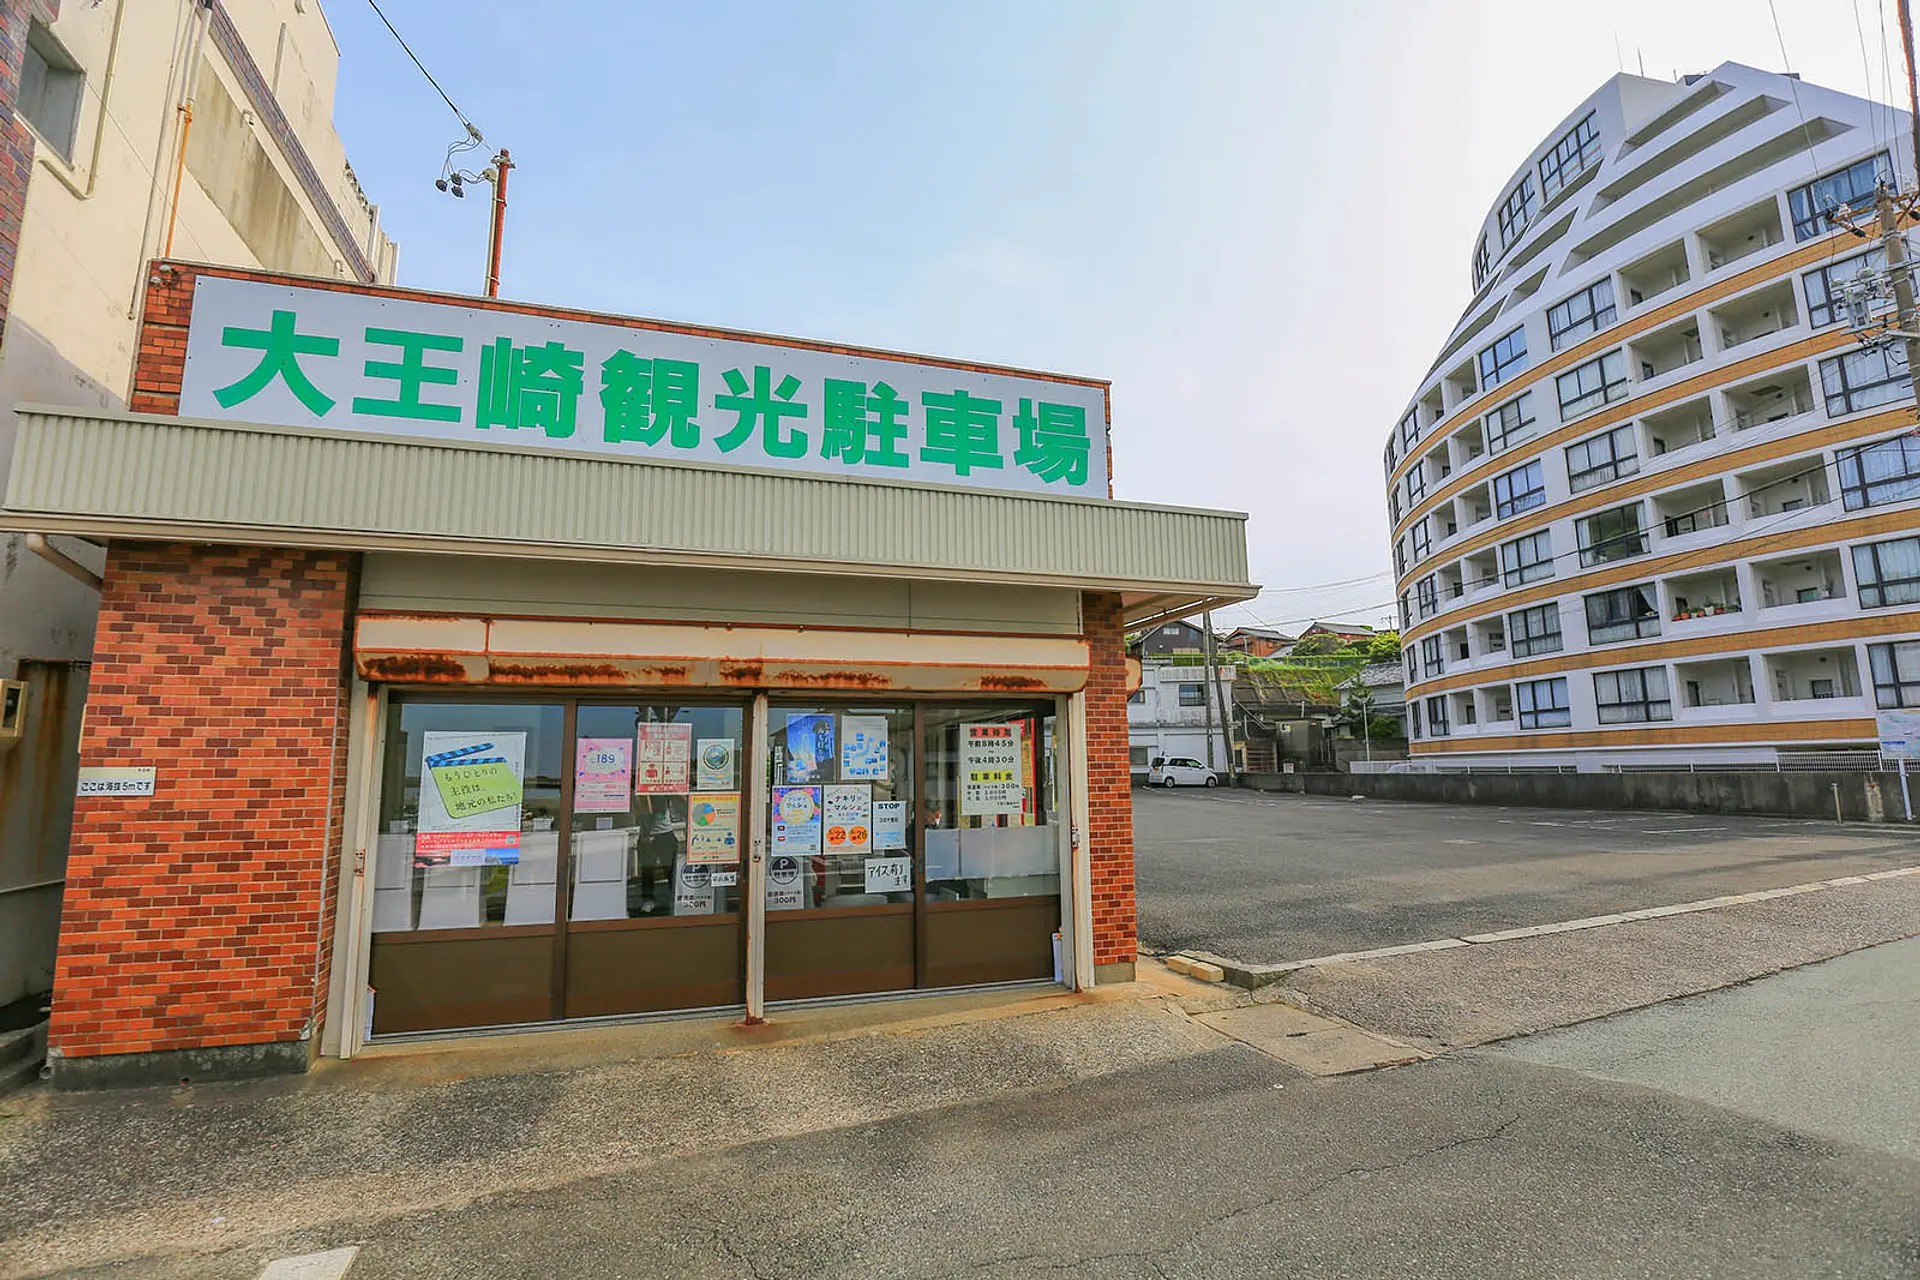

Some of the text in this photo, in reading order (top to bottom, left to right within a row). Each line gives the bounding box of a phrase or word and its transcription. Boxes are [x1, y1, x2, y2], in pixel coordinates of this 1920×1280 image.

[213, 310, 1092, 486] 大王崎観光駐車場
[597, 753, 616, 764] 189
[780, 859, 789, 869] P
